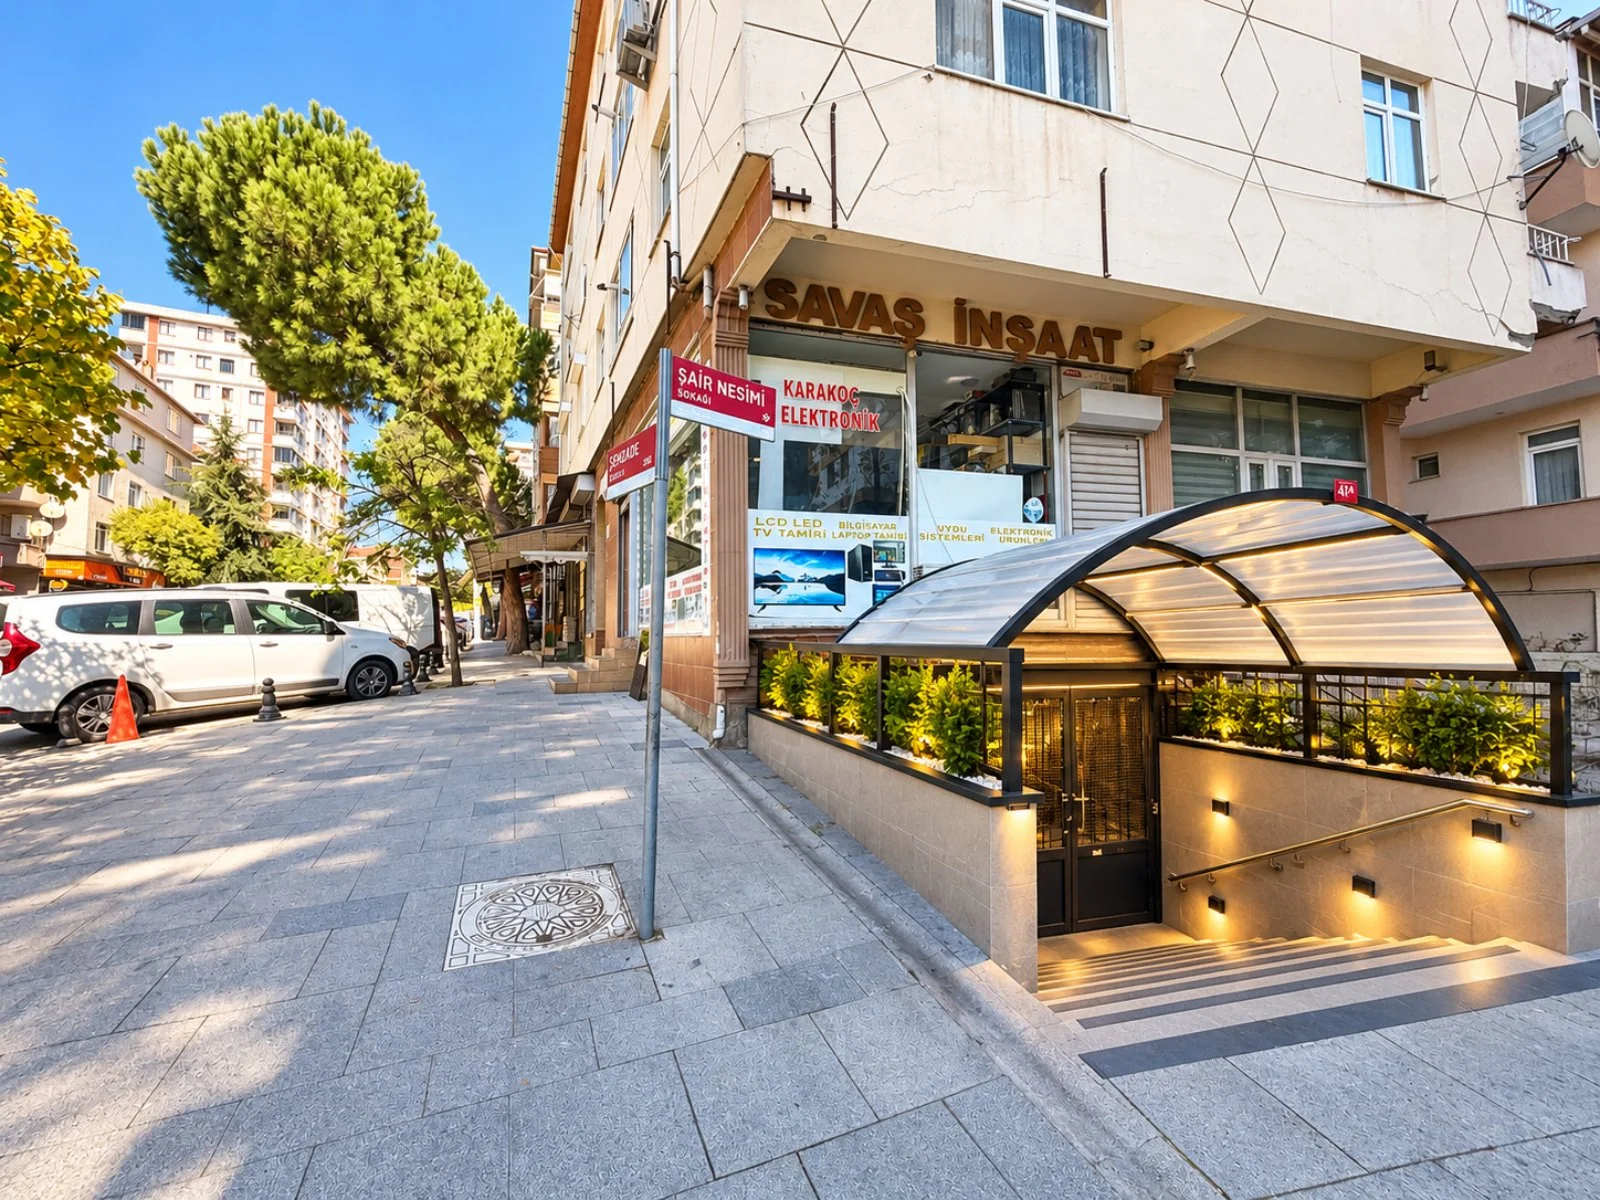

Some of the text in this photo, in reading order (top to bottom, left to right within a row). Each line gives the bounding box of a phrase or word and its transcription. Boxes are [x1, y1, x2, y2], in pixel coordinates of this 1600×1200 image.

[764, 277, 1124, 364] SAVAŞ İNŞAAT
[677, 367, 765, 408] ŞAİR NESİMİ
[783, 379, 860, 408] KARAKOÇ
[781, 405, 881, 432] ELEKTRONİK
[753, 528, 827, 539] TV TAMİRİ
[755, 516, 822, 528] LCD LED
[832, 531, 872, 540] LAPTOP
